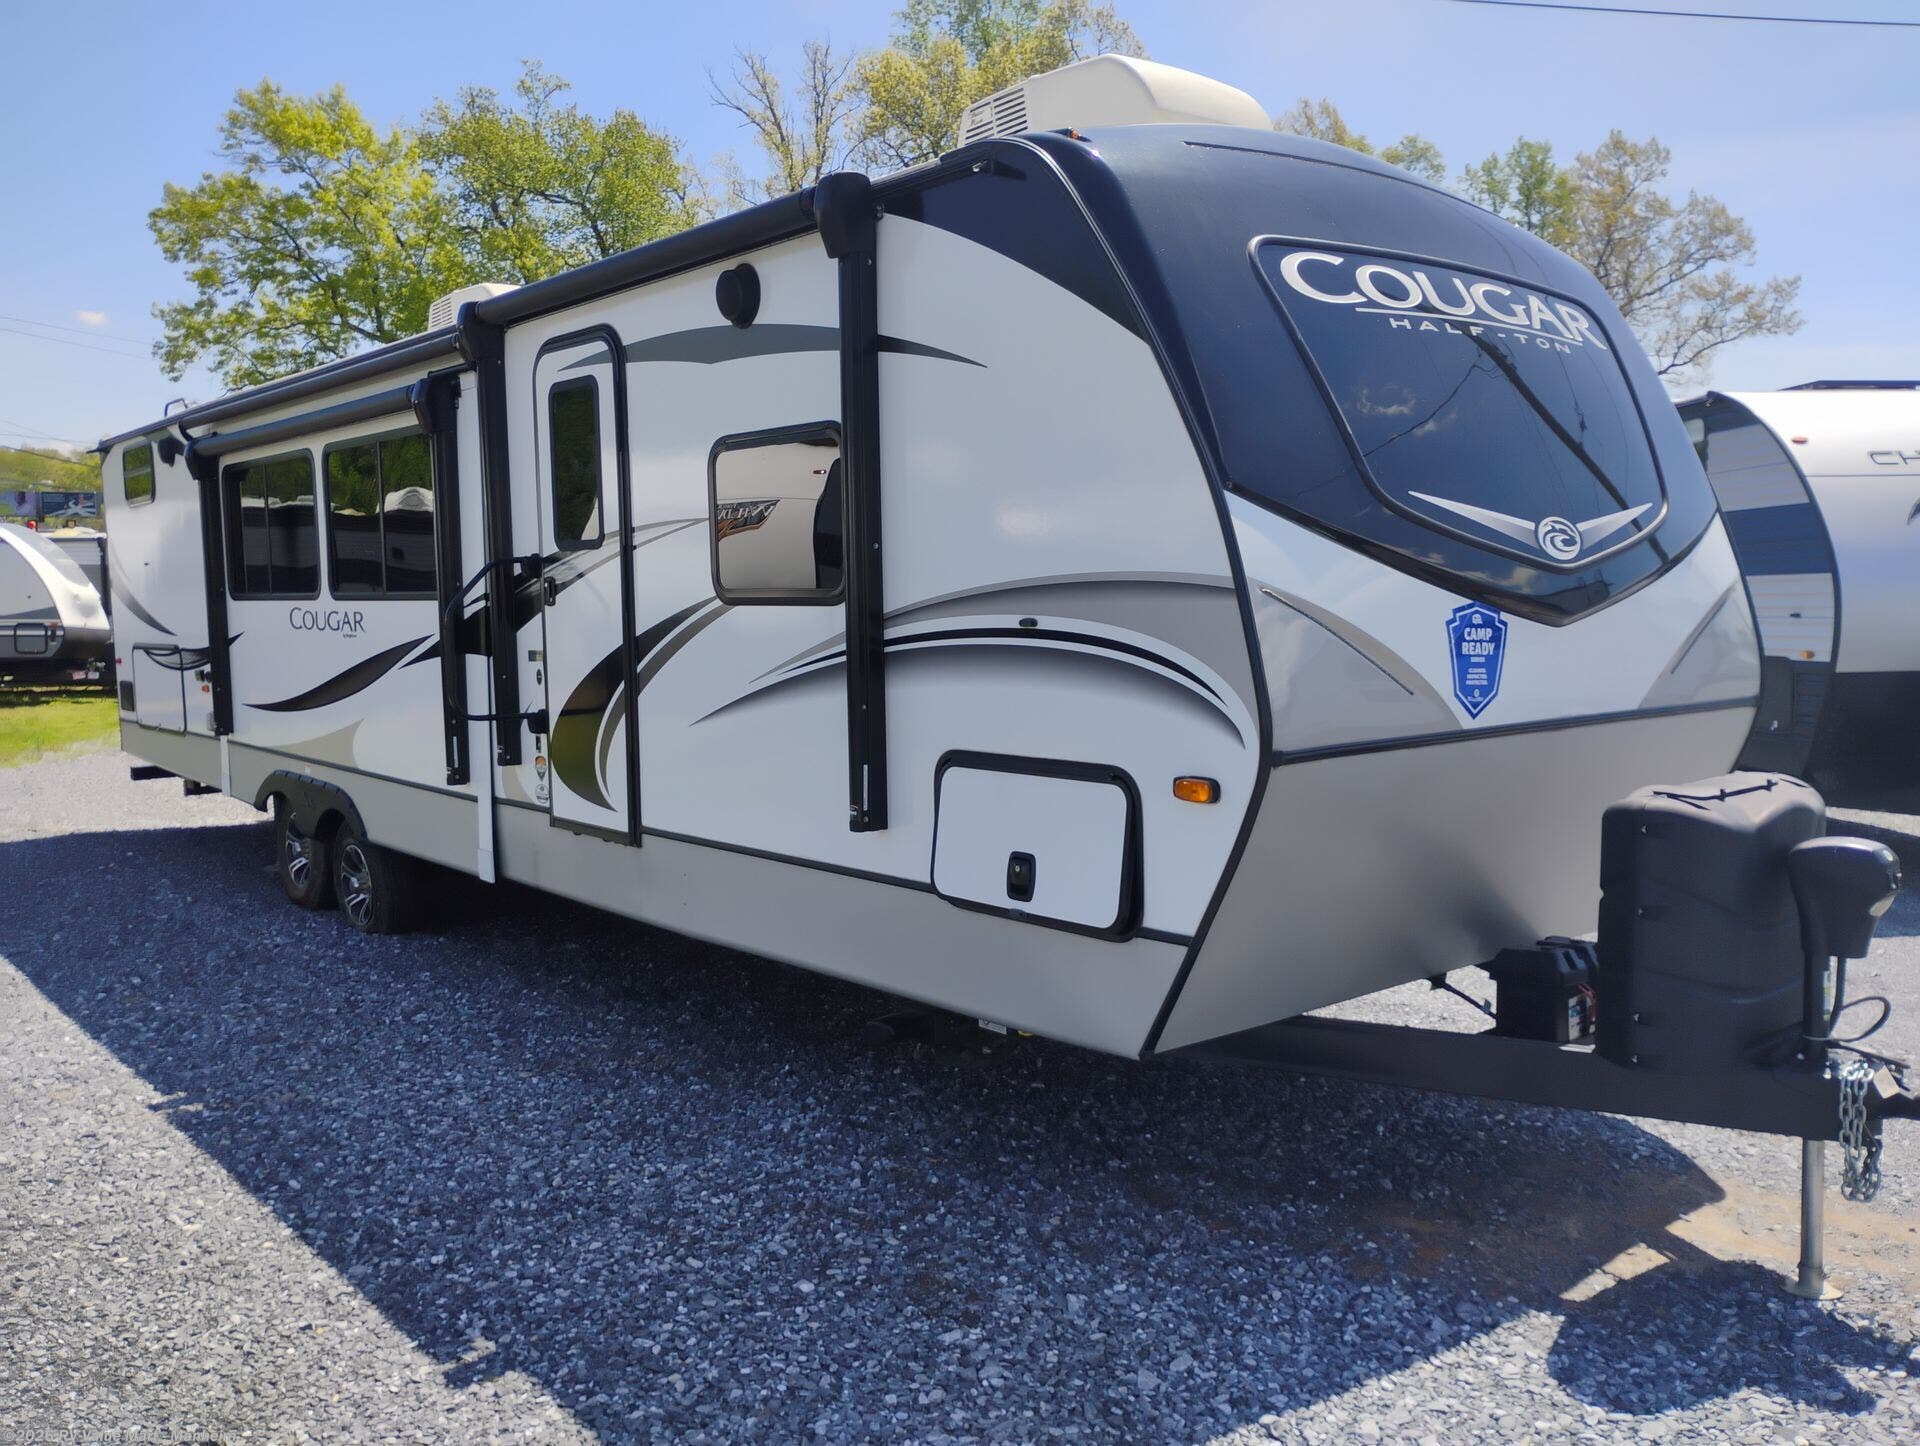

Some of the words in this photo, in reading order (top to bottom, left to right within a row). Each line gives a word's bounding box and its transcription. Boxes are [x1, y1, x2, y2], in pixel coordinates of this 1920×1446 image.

[1280, 251, 1608, 351] COUGAR
[289, 607, 365, 632] COUGAR
[1463, 627, 1493, 641] CAMP
[1461, 642, 1495, 655] READY
